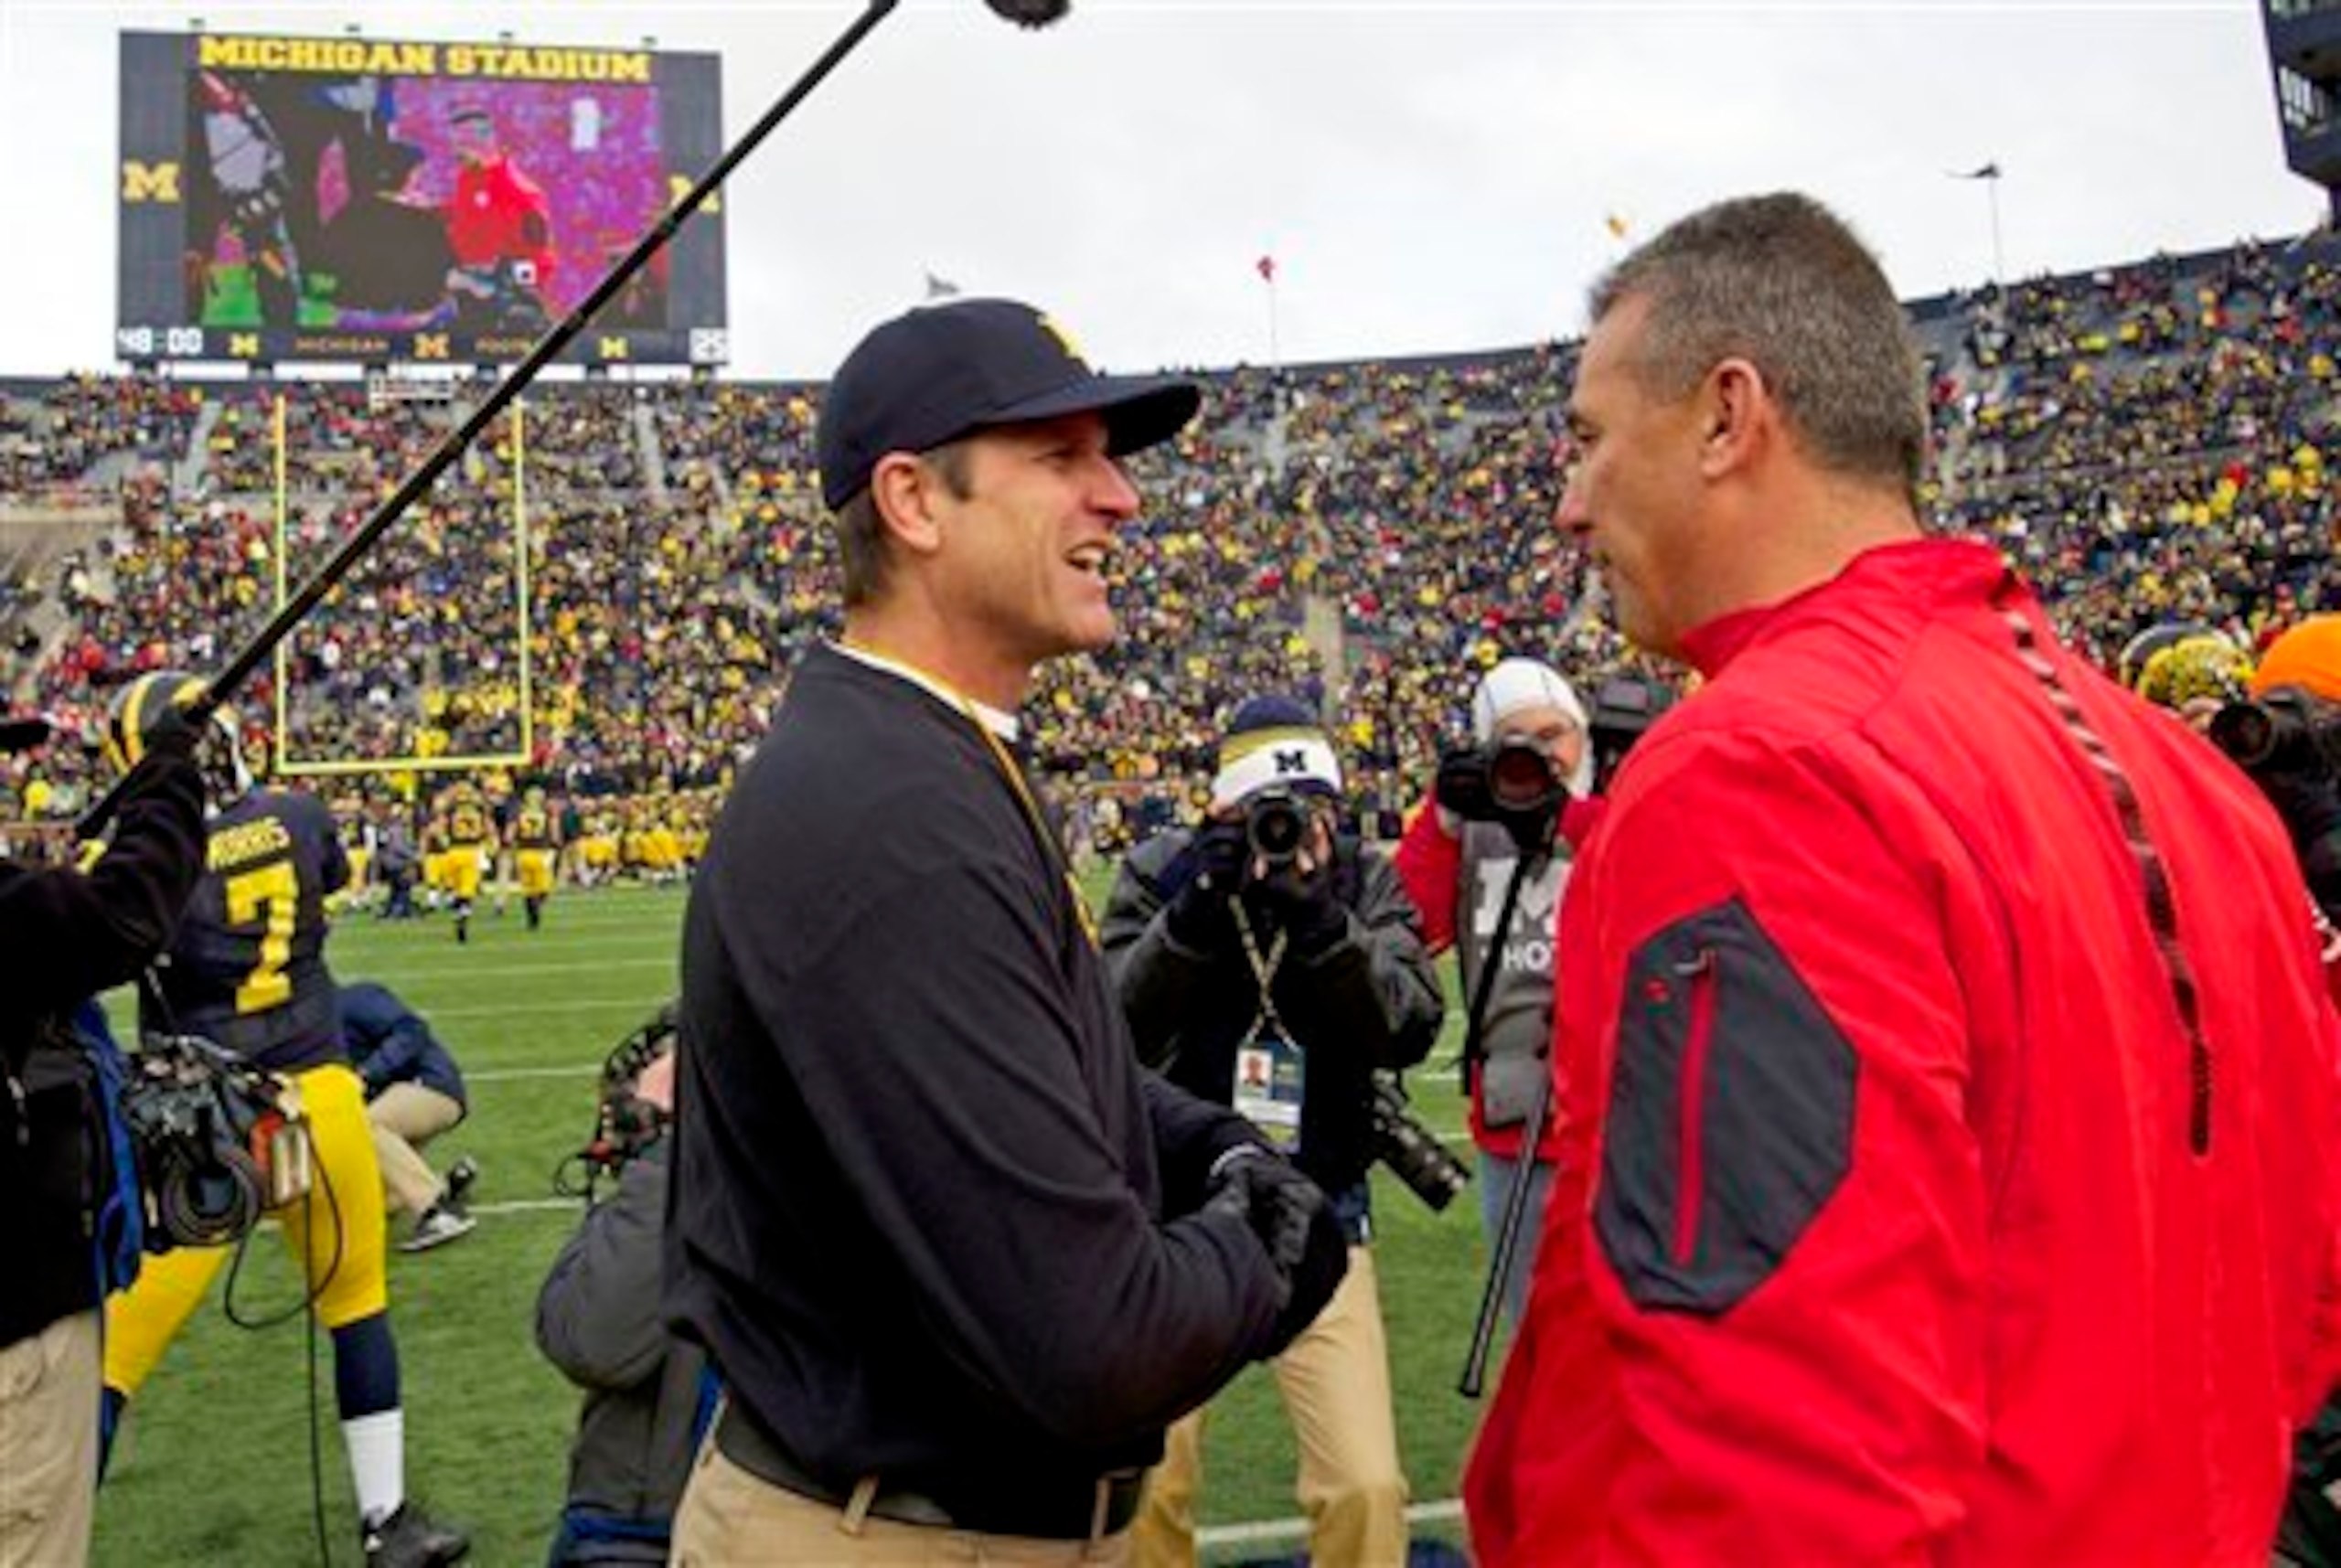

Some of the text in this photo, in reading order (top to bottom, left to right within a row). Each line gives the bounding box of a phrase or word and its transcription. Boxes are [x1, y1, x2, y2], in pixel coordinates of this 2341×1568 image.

[198, 36, 650, 80] MICHIGAN STADIUM
[122, 161, 179, 201] M
[230, 333, 259, 356] M
[414, 333, 449, 358] M
[600, 336, 627, 358] M
[1274, 750, 1307, 772] M
[226, 861, 297, 1014] 7
